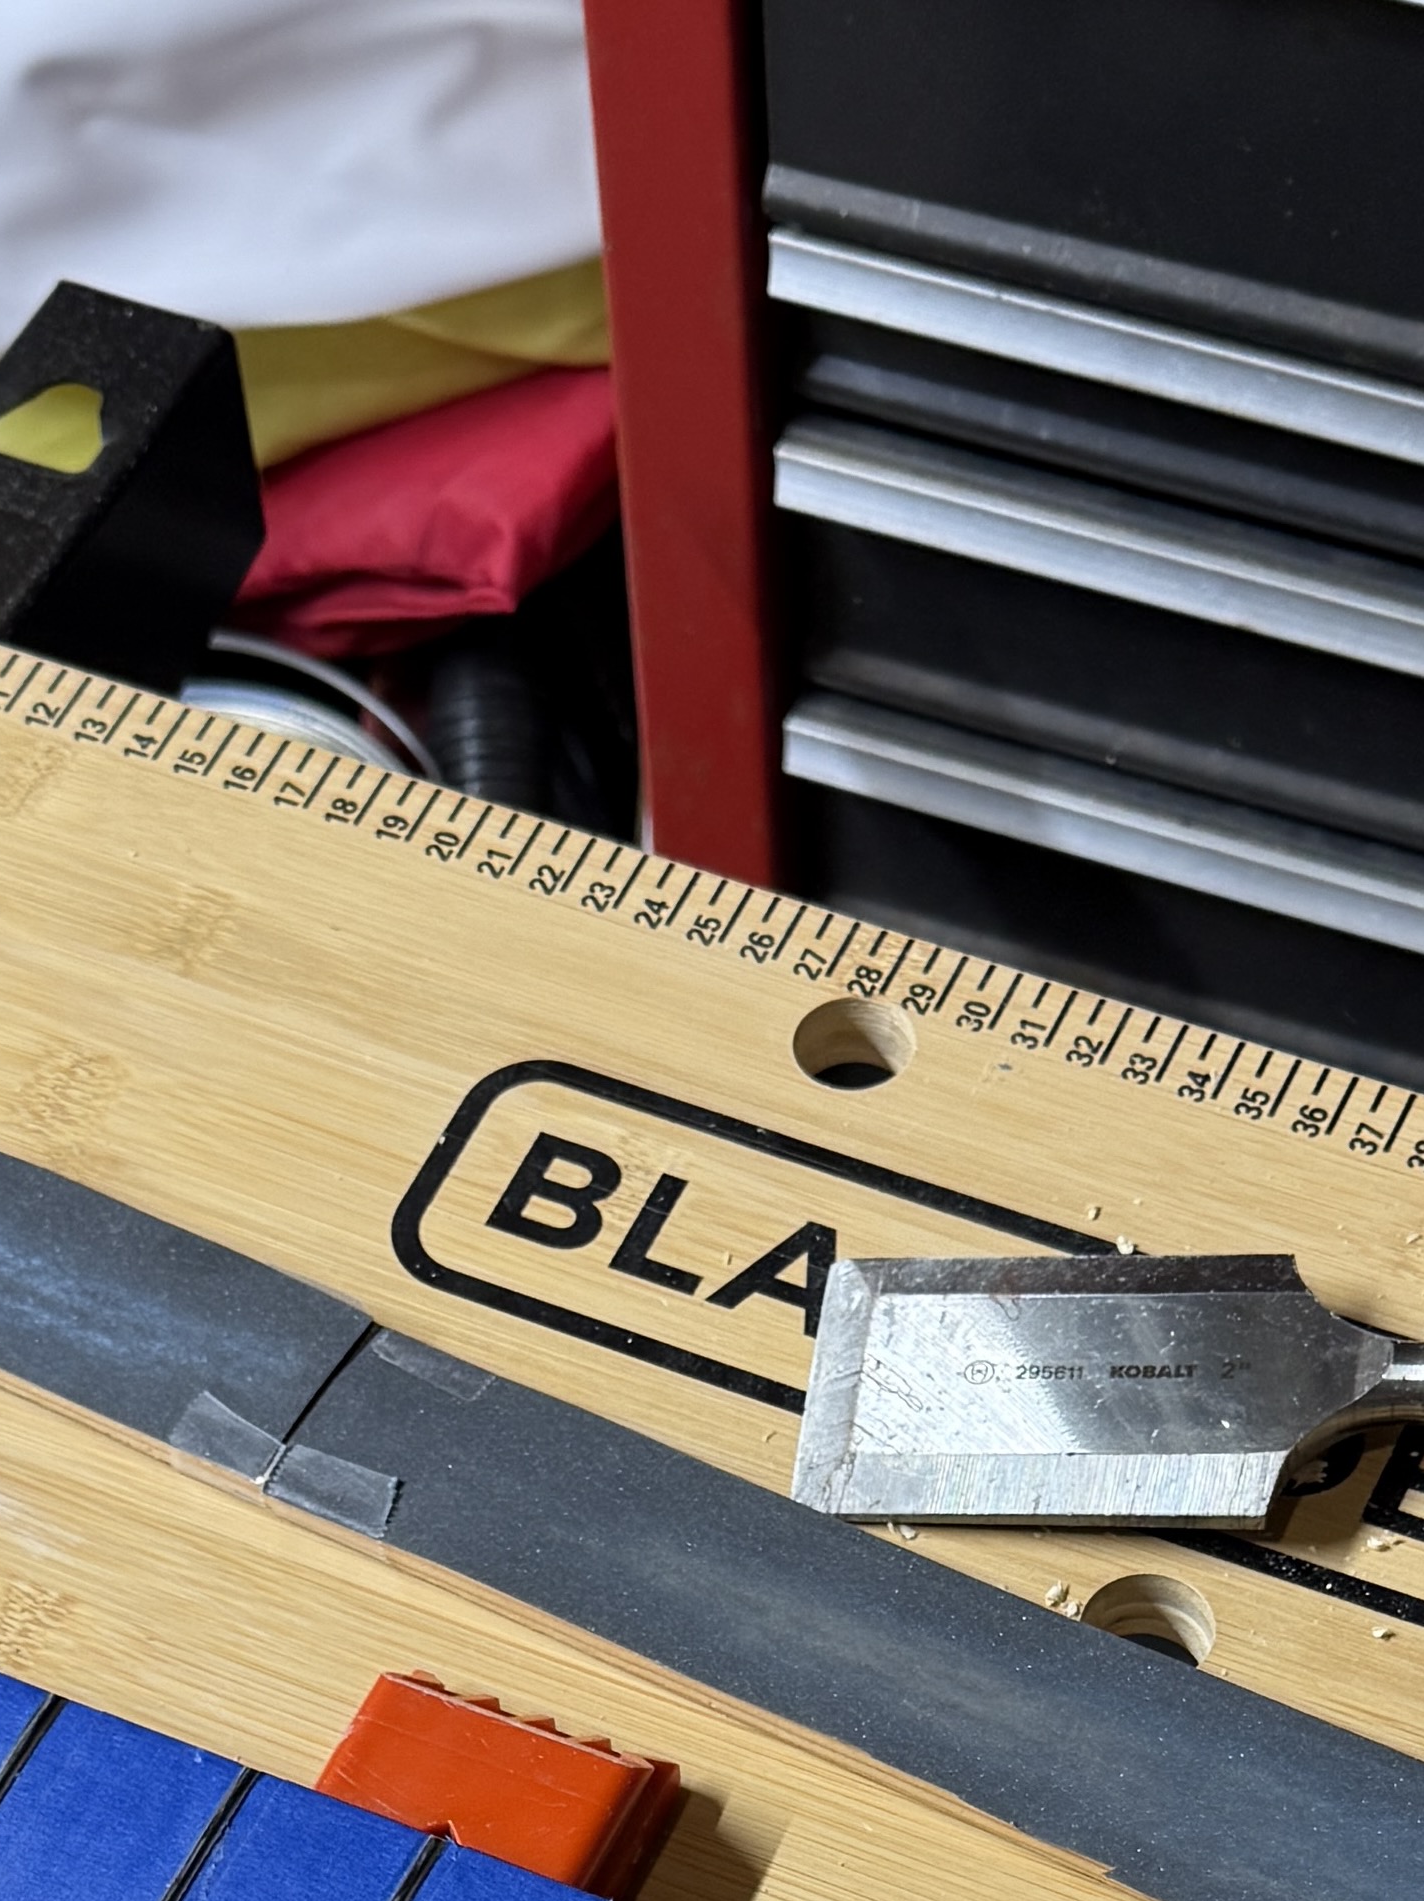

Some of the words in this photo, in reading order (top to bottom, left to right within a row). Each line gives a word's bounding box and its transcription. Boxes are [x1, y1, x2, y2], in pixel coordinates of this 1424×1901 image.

[324, 797, 359, 824] 18
[955, 1000, 992, 1033] 30
[1015, 1363, 1084, 1381] 295611
[1108, 1363, 1199, 1380] KOBALT
